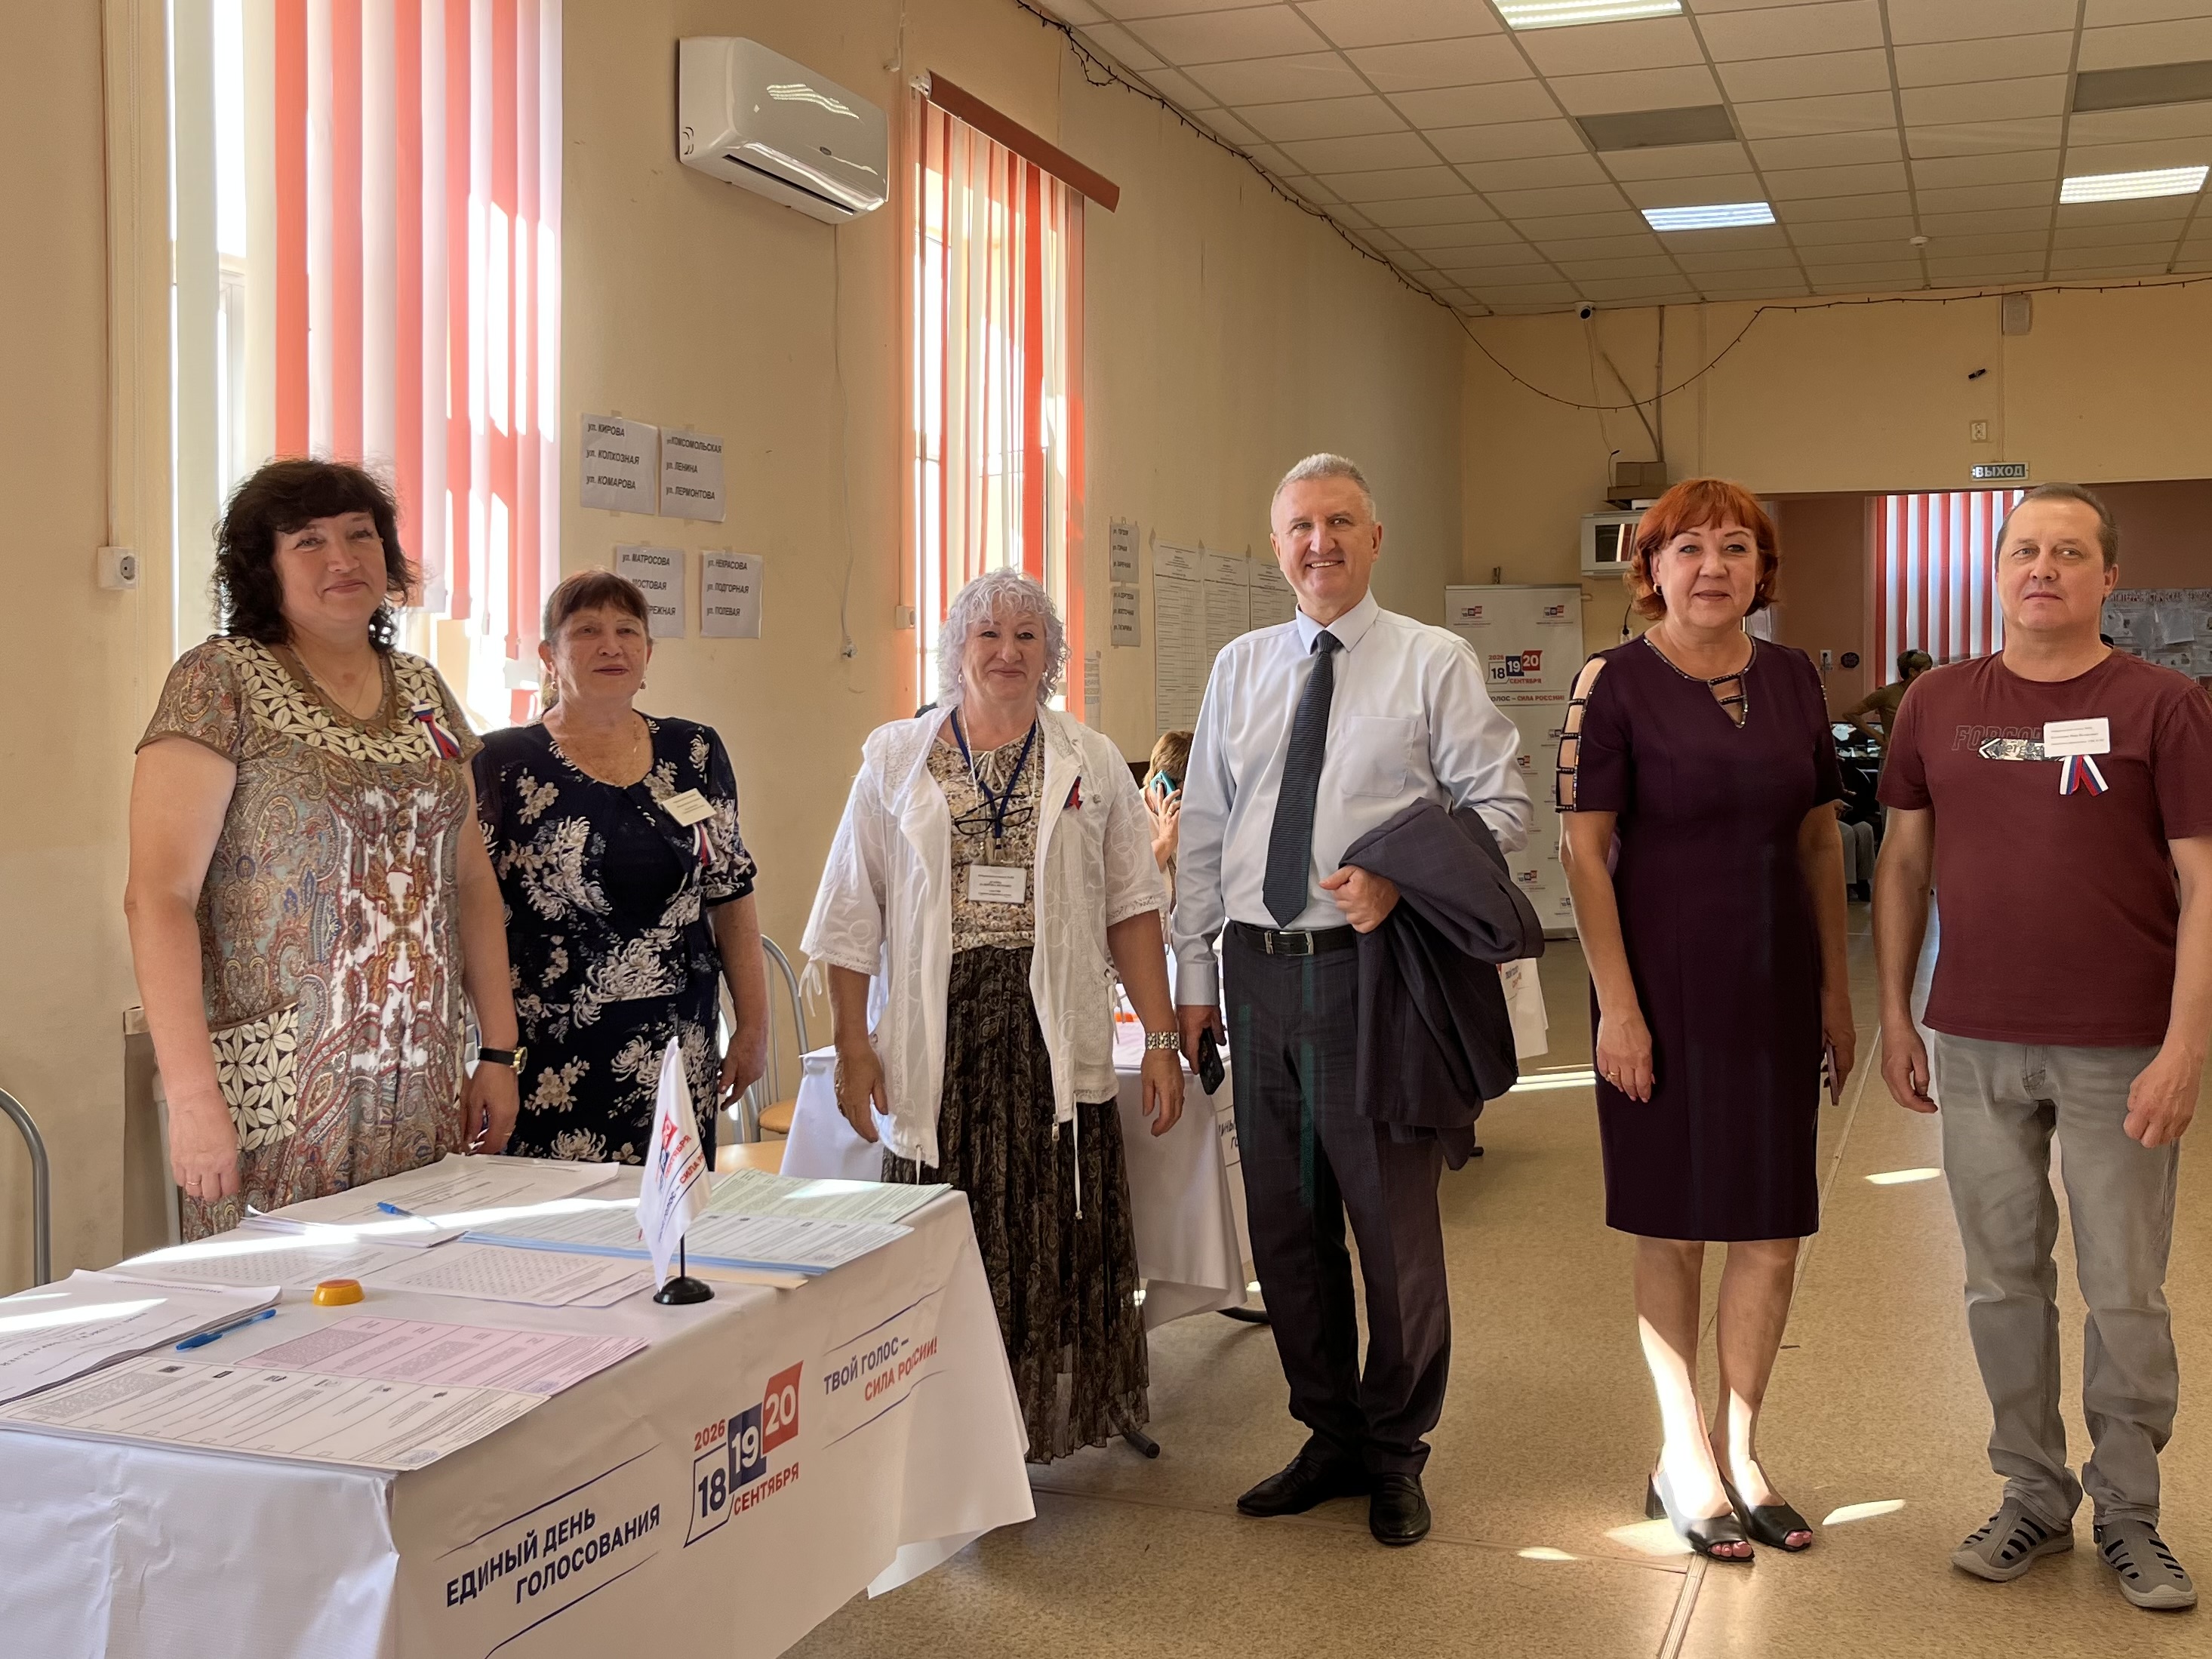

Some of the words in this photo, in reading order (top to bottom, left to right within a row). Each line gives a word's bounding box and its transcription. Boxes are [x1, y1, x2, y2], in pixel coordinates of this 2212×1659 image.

[587, 423, 597, 432] ул.
[598, 424, 625, 437] КИРОВА
[586, 449, 597, 459] ул.
[598, 450, 640, 465] КОЛХОЗНАЯ
[675, 462, 698, 473] ЛЕНИНА
[1975, 466, 2023, 478] ВЫХОД
[586, 476, 597, 485] ул.
[598, 476, 636, 490] КОМАРОВА
[675, 486, 715, 500] ЛЕРМОНТОВА
[632, 554, 670, 566] МАТРОСОВА
[716, 559, 748, 570] НЕКРАСОВА
[715, 583, 749, 594] ПОДГОРНАЯ
[715, 606, 740, 617] ПОЛЕВАЯ
[1491, 668, 1505, 679] 18
[1507, 660, 1520, 673] 19
[1523, 655, 1539, 666] 20
[679, 1159, 700, 1185] СИЛА
[823, 1355, 858, 1396] ТВОЙ
[861, 1337, 899, 1375] ГОЛОС
[864, 1367, 895, 1402] СИЛА
[694, 1418, 726, 1452] 2026
[698, 1467, 726, 1519] 18
[731, 1425, 759, 1474] 19
[765, 1384, 796, 1437] 20
[734, 1461, 799, 1516] СЕНТЯБРЯ
[447, 1528, 537, 1608] ЕДИНЫЙ
[543, 1508, 595, 1558] ДЕНЬ
[516, 1503, 660, 1605] ГОЛОСОВАНИЯ
